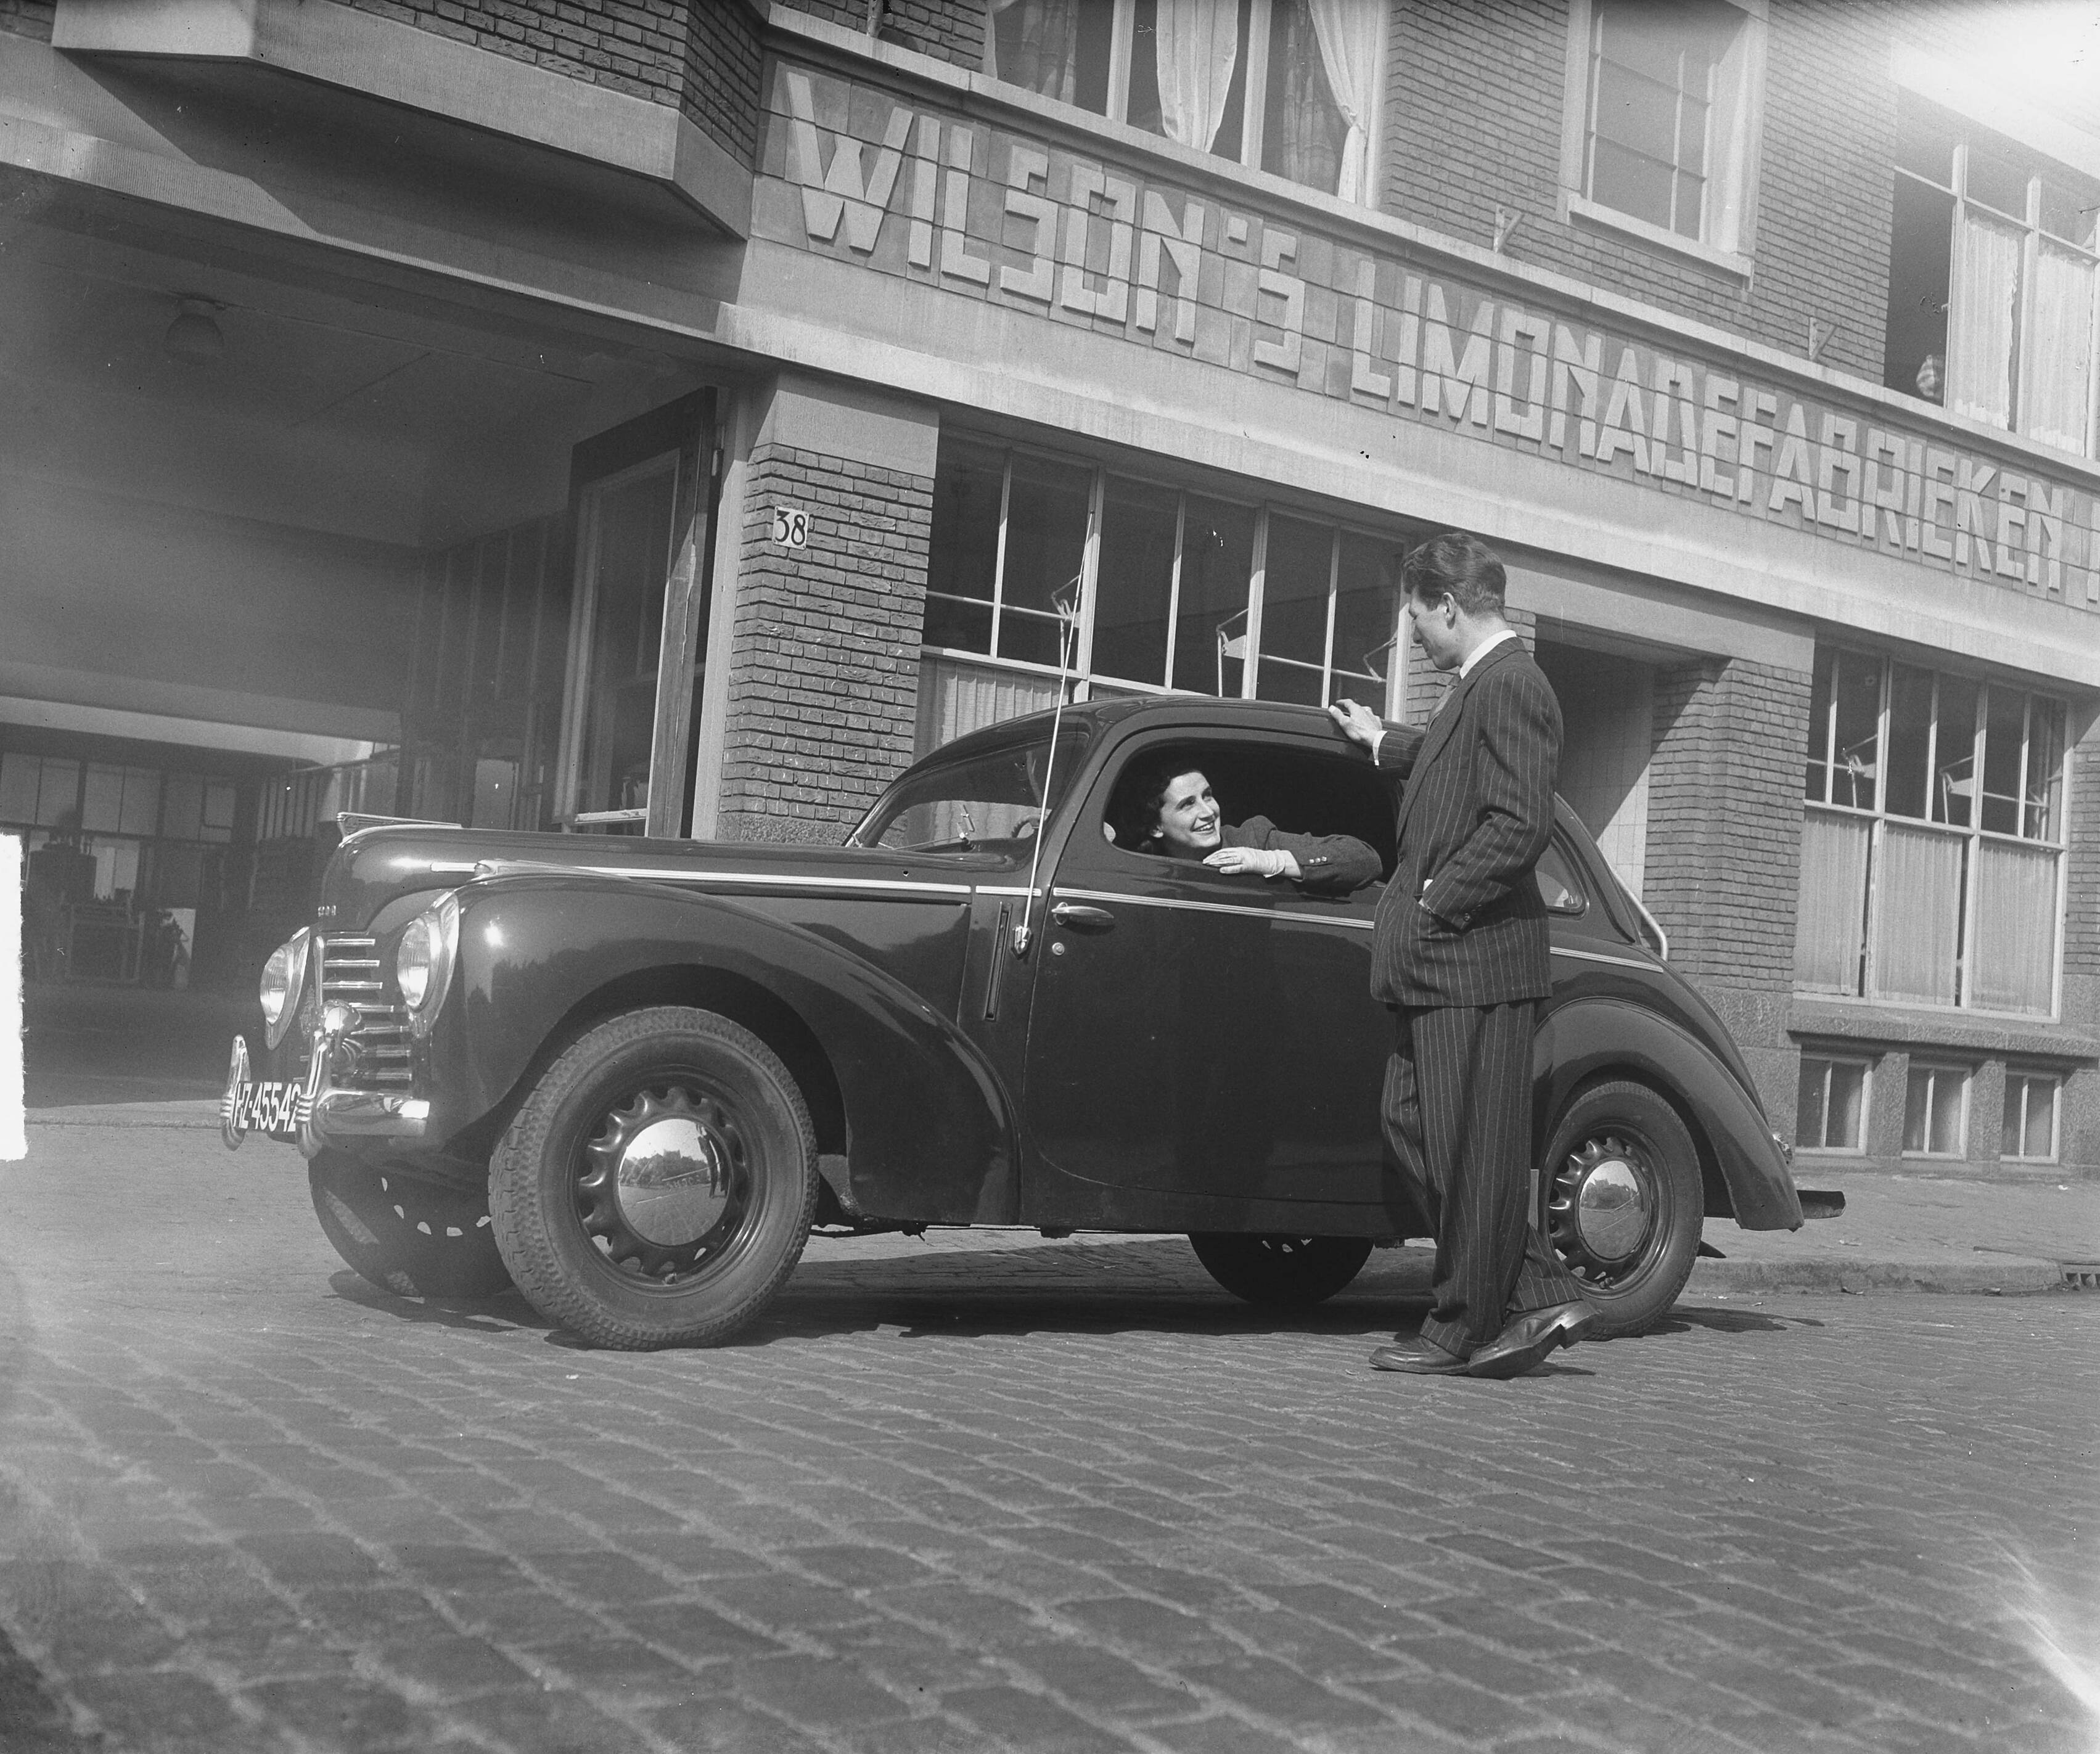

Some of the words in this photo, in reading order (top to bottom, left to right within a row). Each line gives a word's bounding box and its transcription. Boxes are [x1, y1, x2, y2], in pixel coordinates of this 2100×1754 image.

[786, 71, 1306, 374] WILSON'S
[1351, 260, 2064, 592] LIMONADEFABRIEKEN
[774, 509, 806, 546] 38
